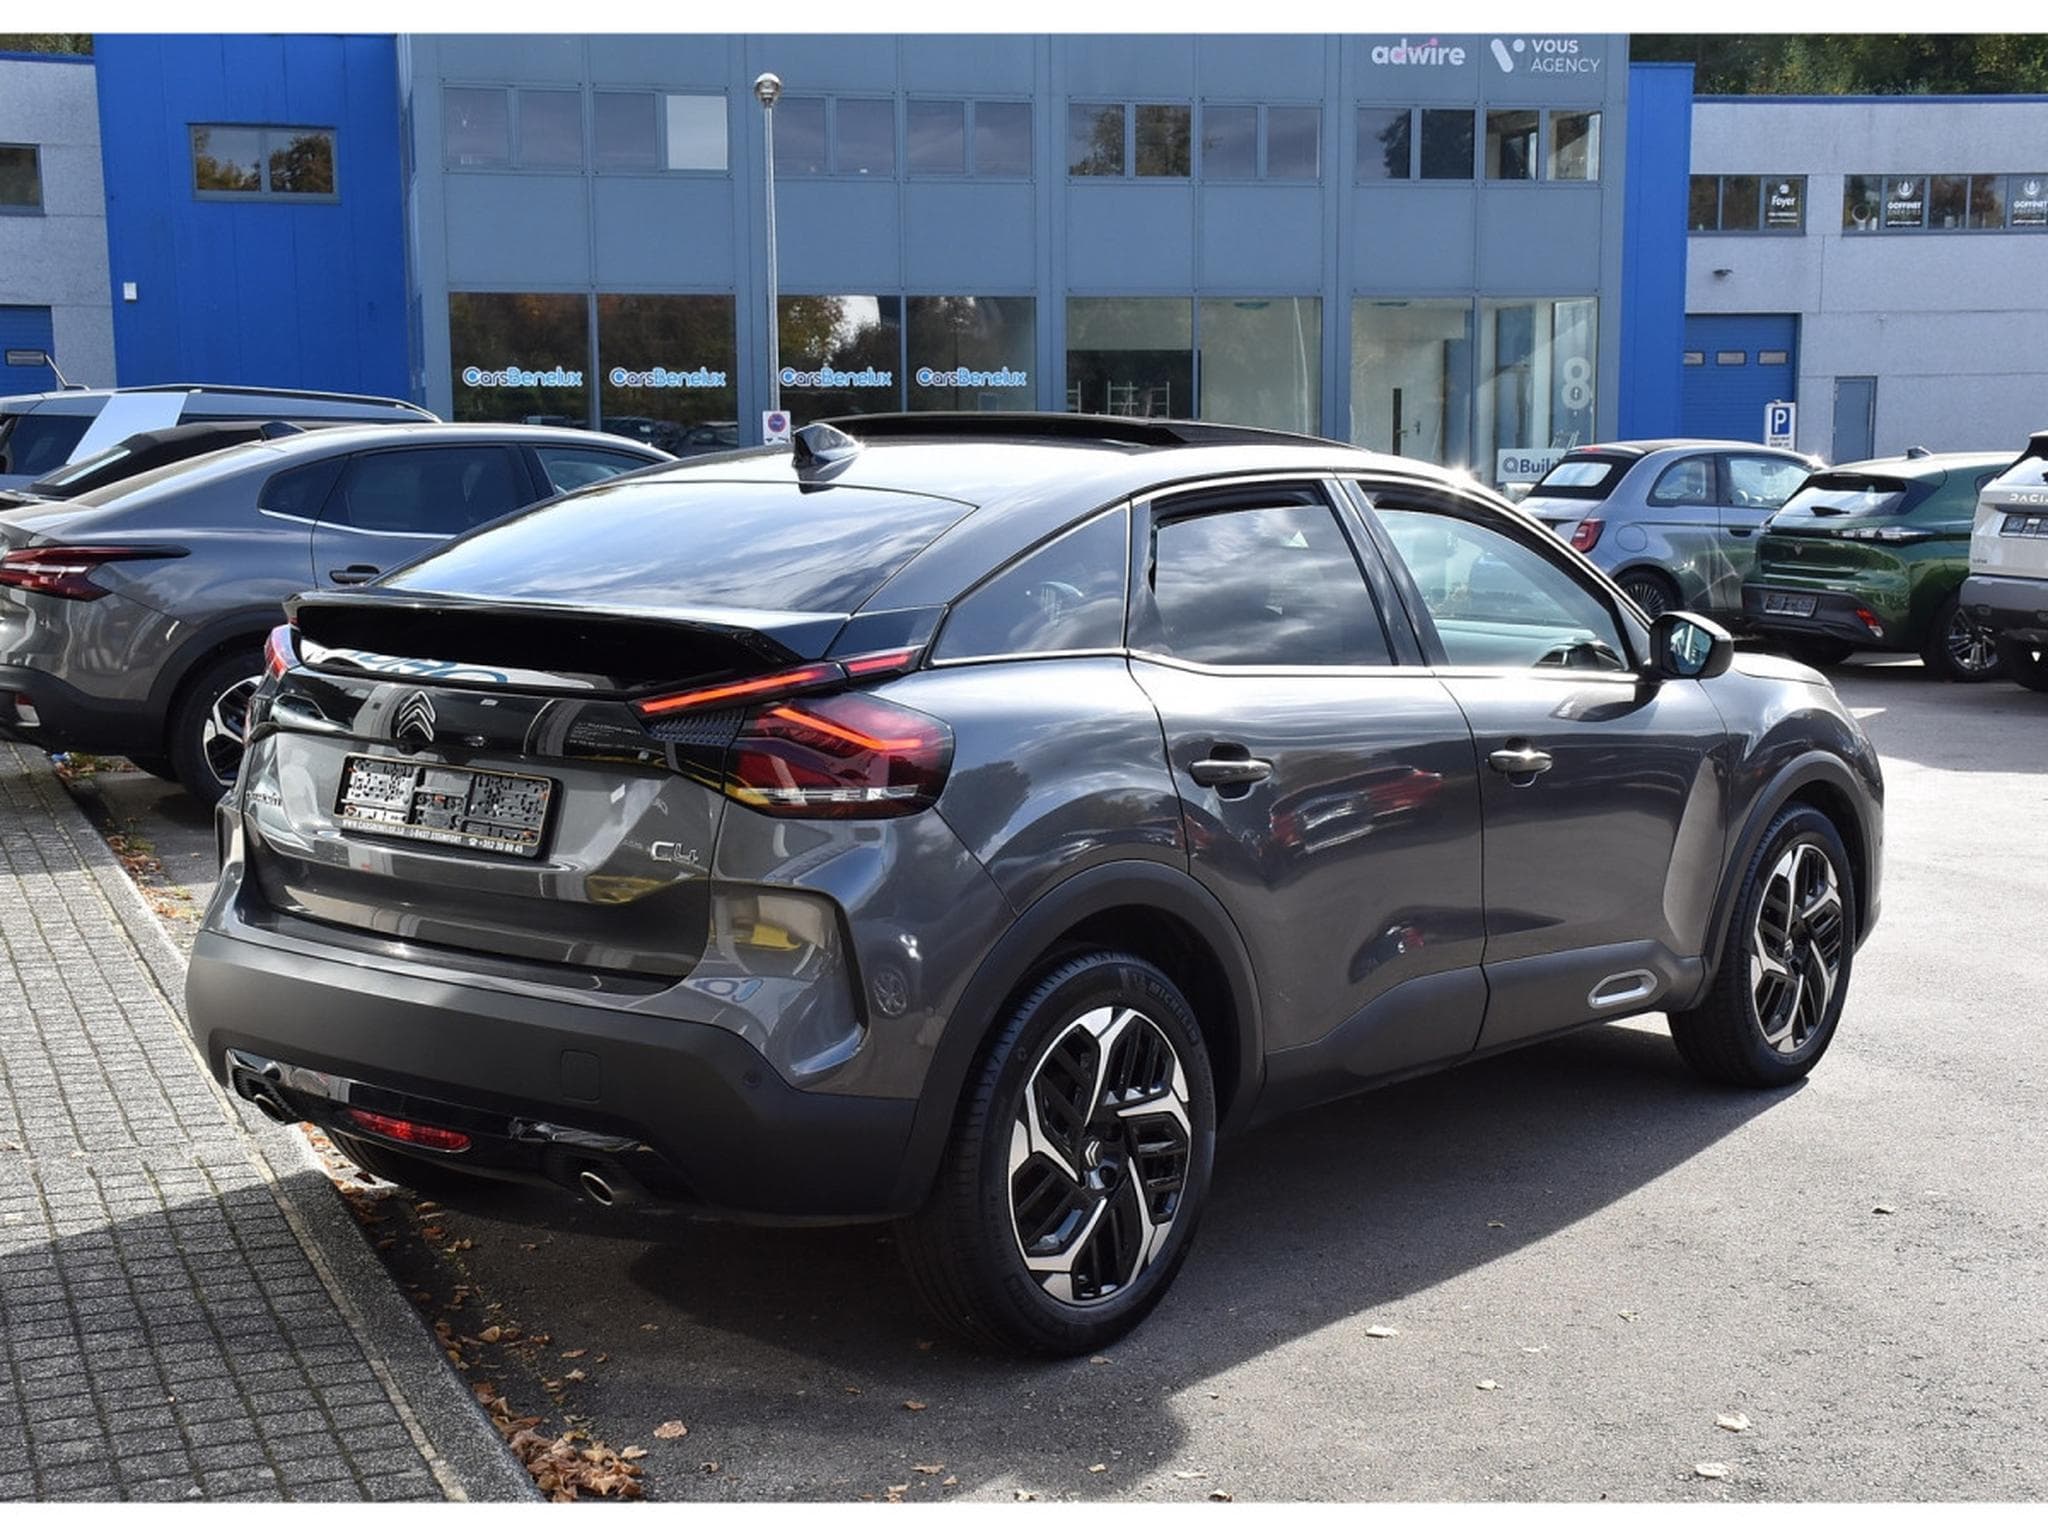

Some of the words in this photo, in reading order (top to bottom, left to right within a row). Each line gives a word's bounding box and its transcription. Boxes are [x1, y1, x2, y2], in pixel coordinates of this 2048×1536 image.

[1371, 38, 1466, 65] adwire
[1531, 39, 1579, 54] VOUS
[1530, 58, 1600, 72] AGENCY
[1771, 195, 1796, 208] Foyer
[462, 366, 583, 387] CarsBenelux
[609, 366, 726, 387] CarsBenelux
[779, 366, 892, 387] CarsBenelux
[916, 366, 1027, 387] CarsBenelux
[1562, 356, 1591, 410] 8
[1774, 409, 1787, 433] P
[2009, 493, 2048, 503] DACI
